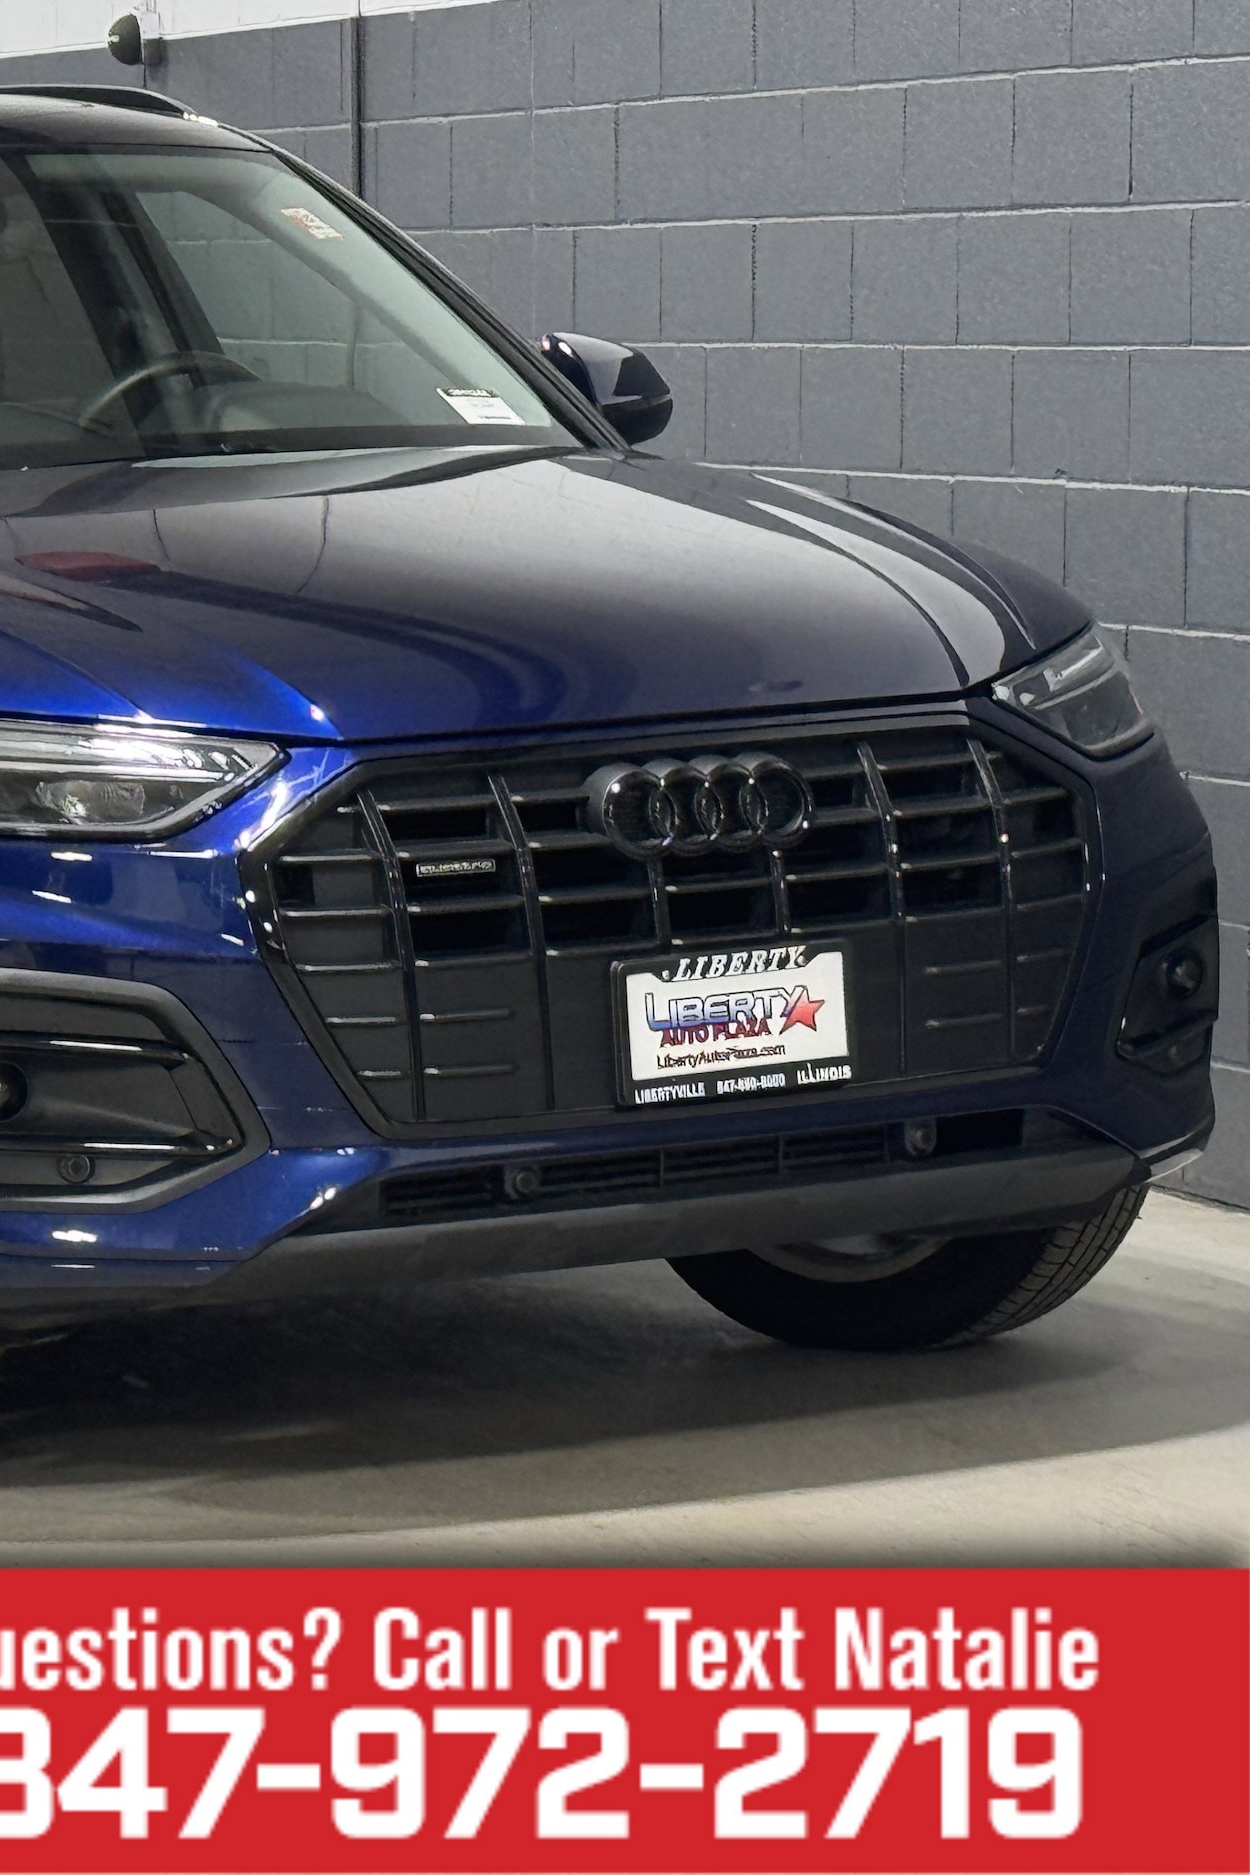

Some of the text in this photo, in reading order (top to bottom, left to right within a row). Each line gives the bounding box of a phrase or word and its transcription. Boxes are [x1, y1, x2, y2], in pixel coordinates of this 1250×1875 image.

[670, 946, 806, 982] LIBERTY
[645, 985, 808, 1031] LIBERTY
[660, 1017, 771, 1048] AUTO PLAZA
[797, 1062, 852, 1085] ILLINOIS
